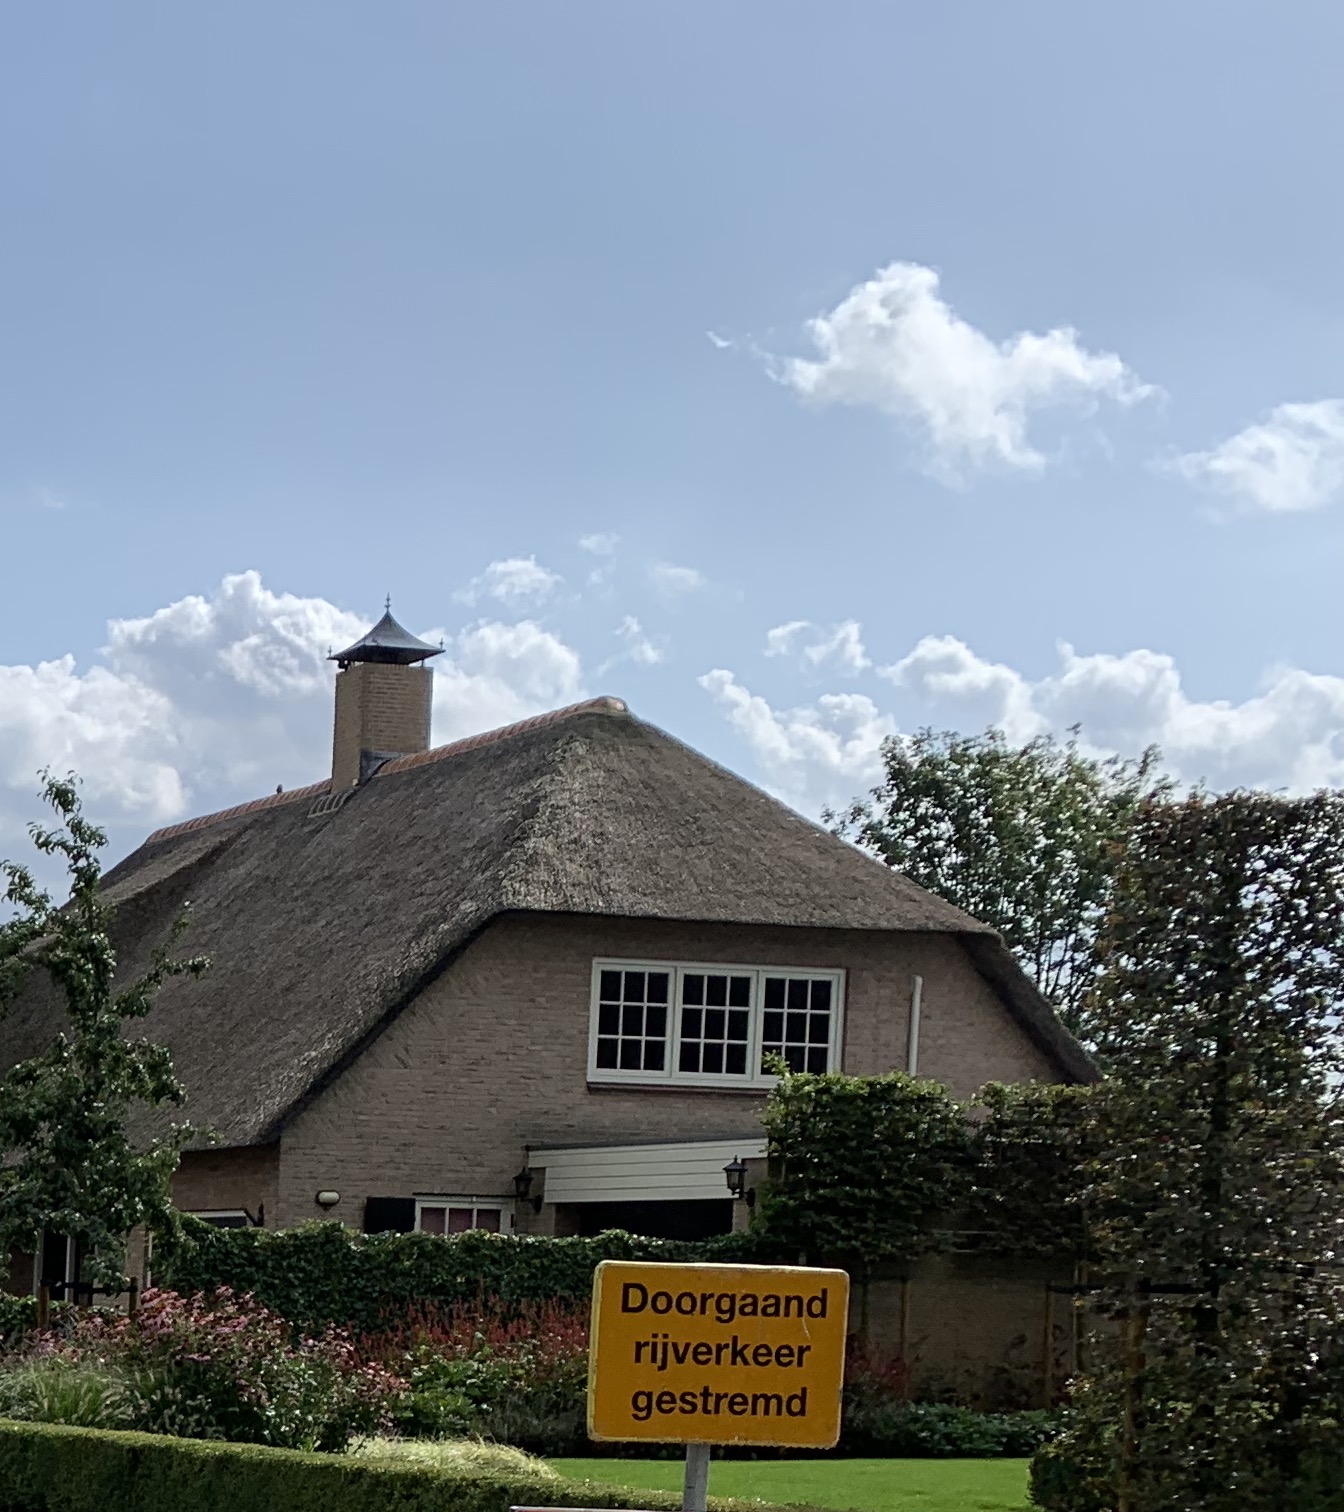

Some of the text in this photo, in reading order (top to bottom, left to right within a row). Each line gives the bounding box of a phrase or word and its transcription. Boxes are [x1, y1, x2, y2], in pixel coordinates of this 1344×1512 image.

[621, 1282, 828, 1324] Doorgaand
[634, 1333, 812, 1372] rijverkeer
[631, 1385, 808, 1422] gestremd
